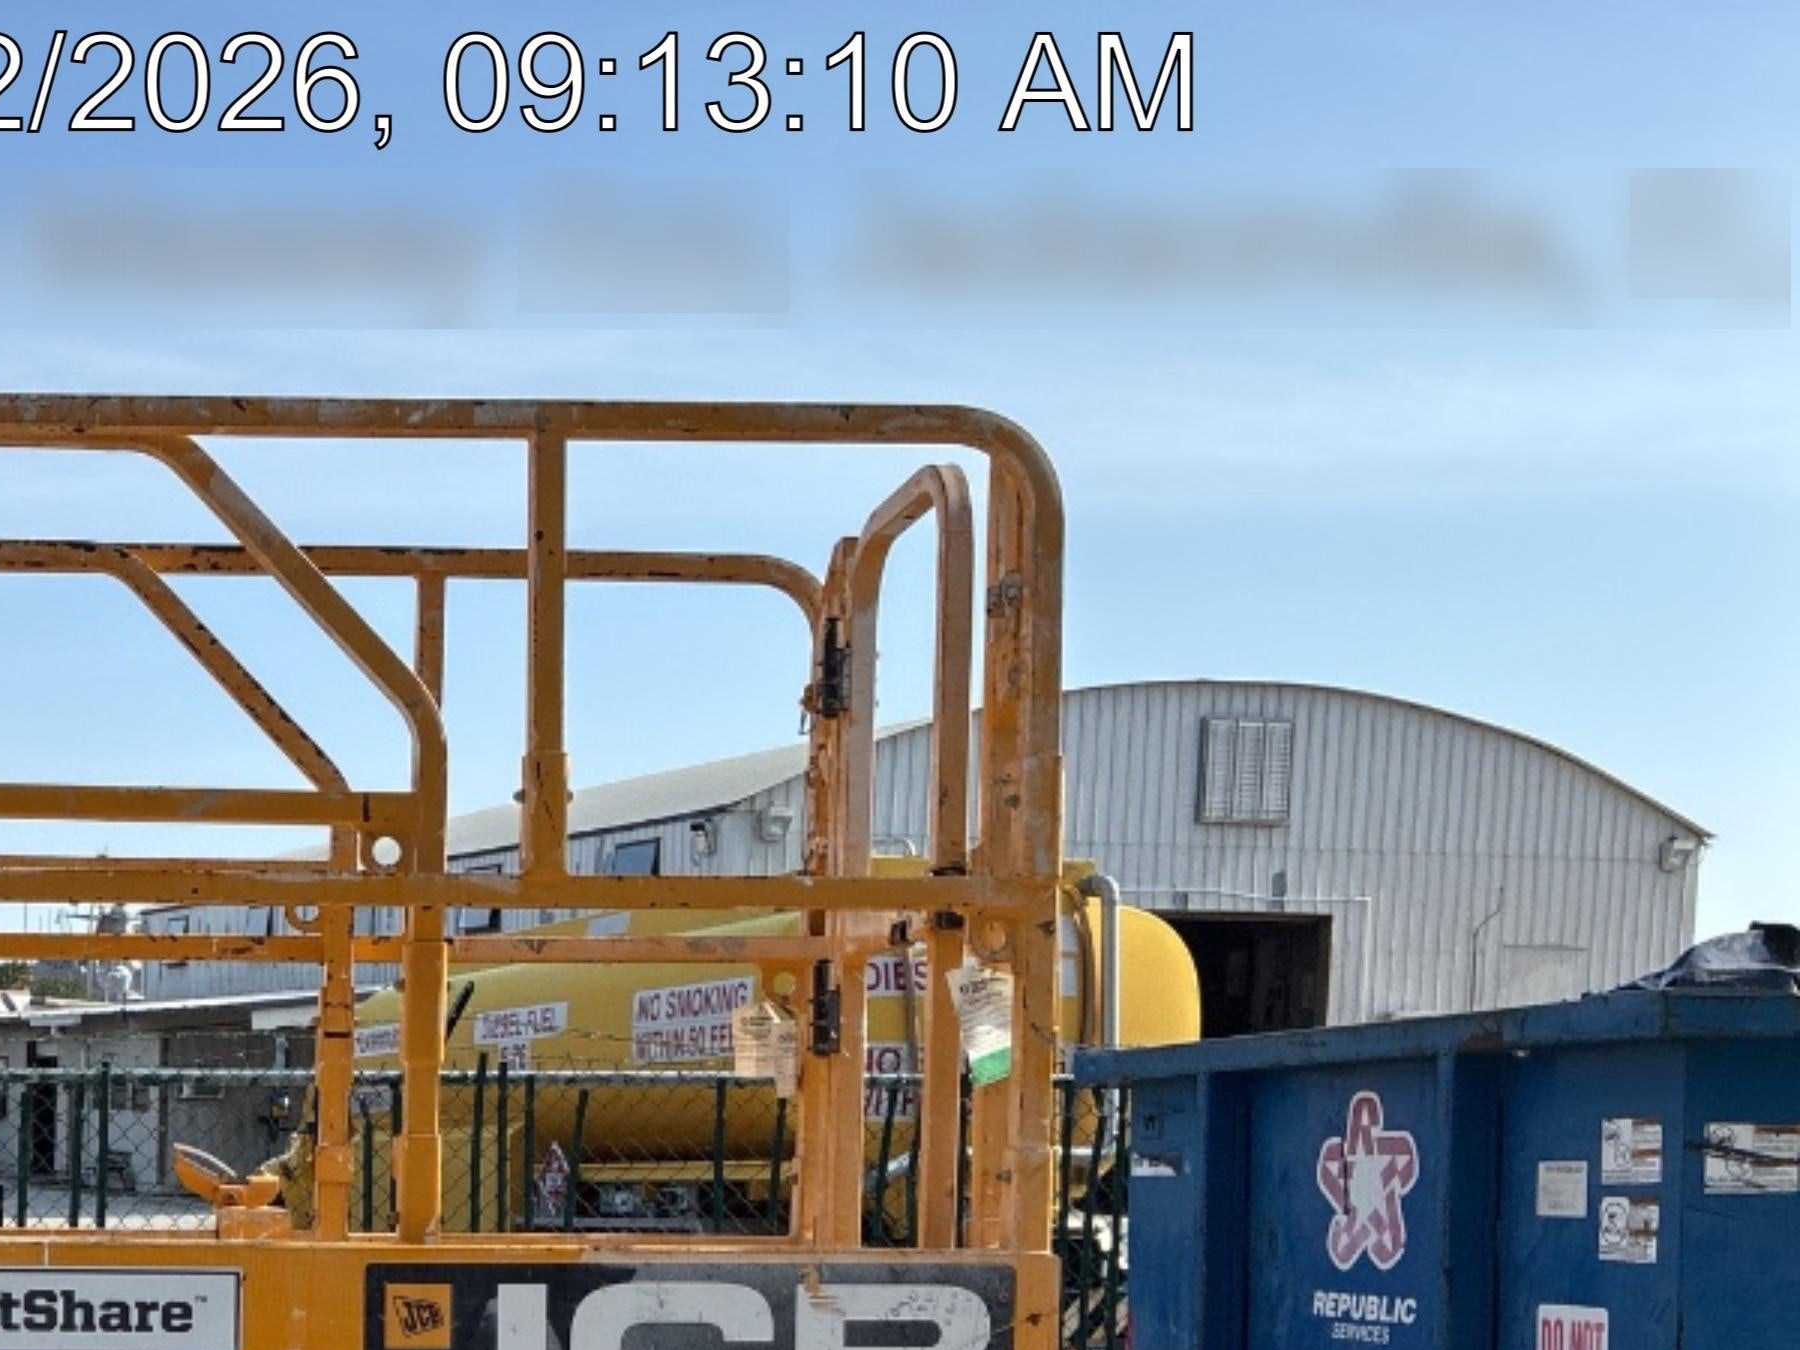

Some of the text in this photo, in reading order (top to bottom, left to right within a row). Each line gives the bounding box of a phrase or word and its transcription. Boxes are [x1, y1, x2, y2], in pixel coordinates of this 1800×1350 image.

[866, 961, 928, 991] DIES
[637, 981, 748, 1022] NO SMOKING
[1313, 1290, 1417, 1325] REPUBLIC
[1331, 1322, 1390, 1344] SERVICES
